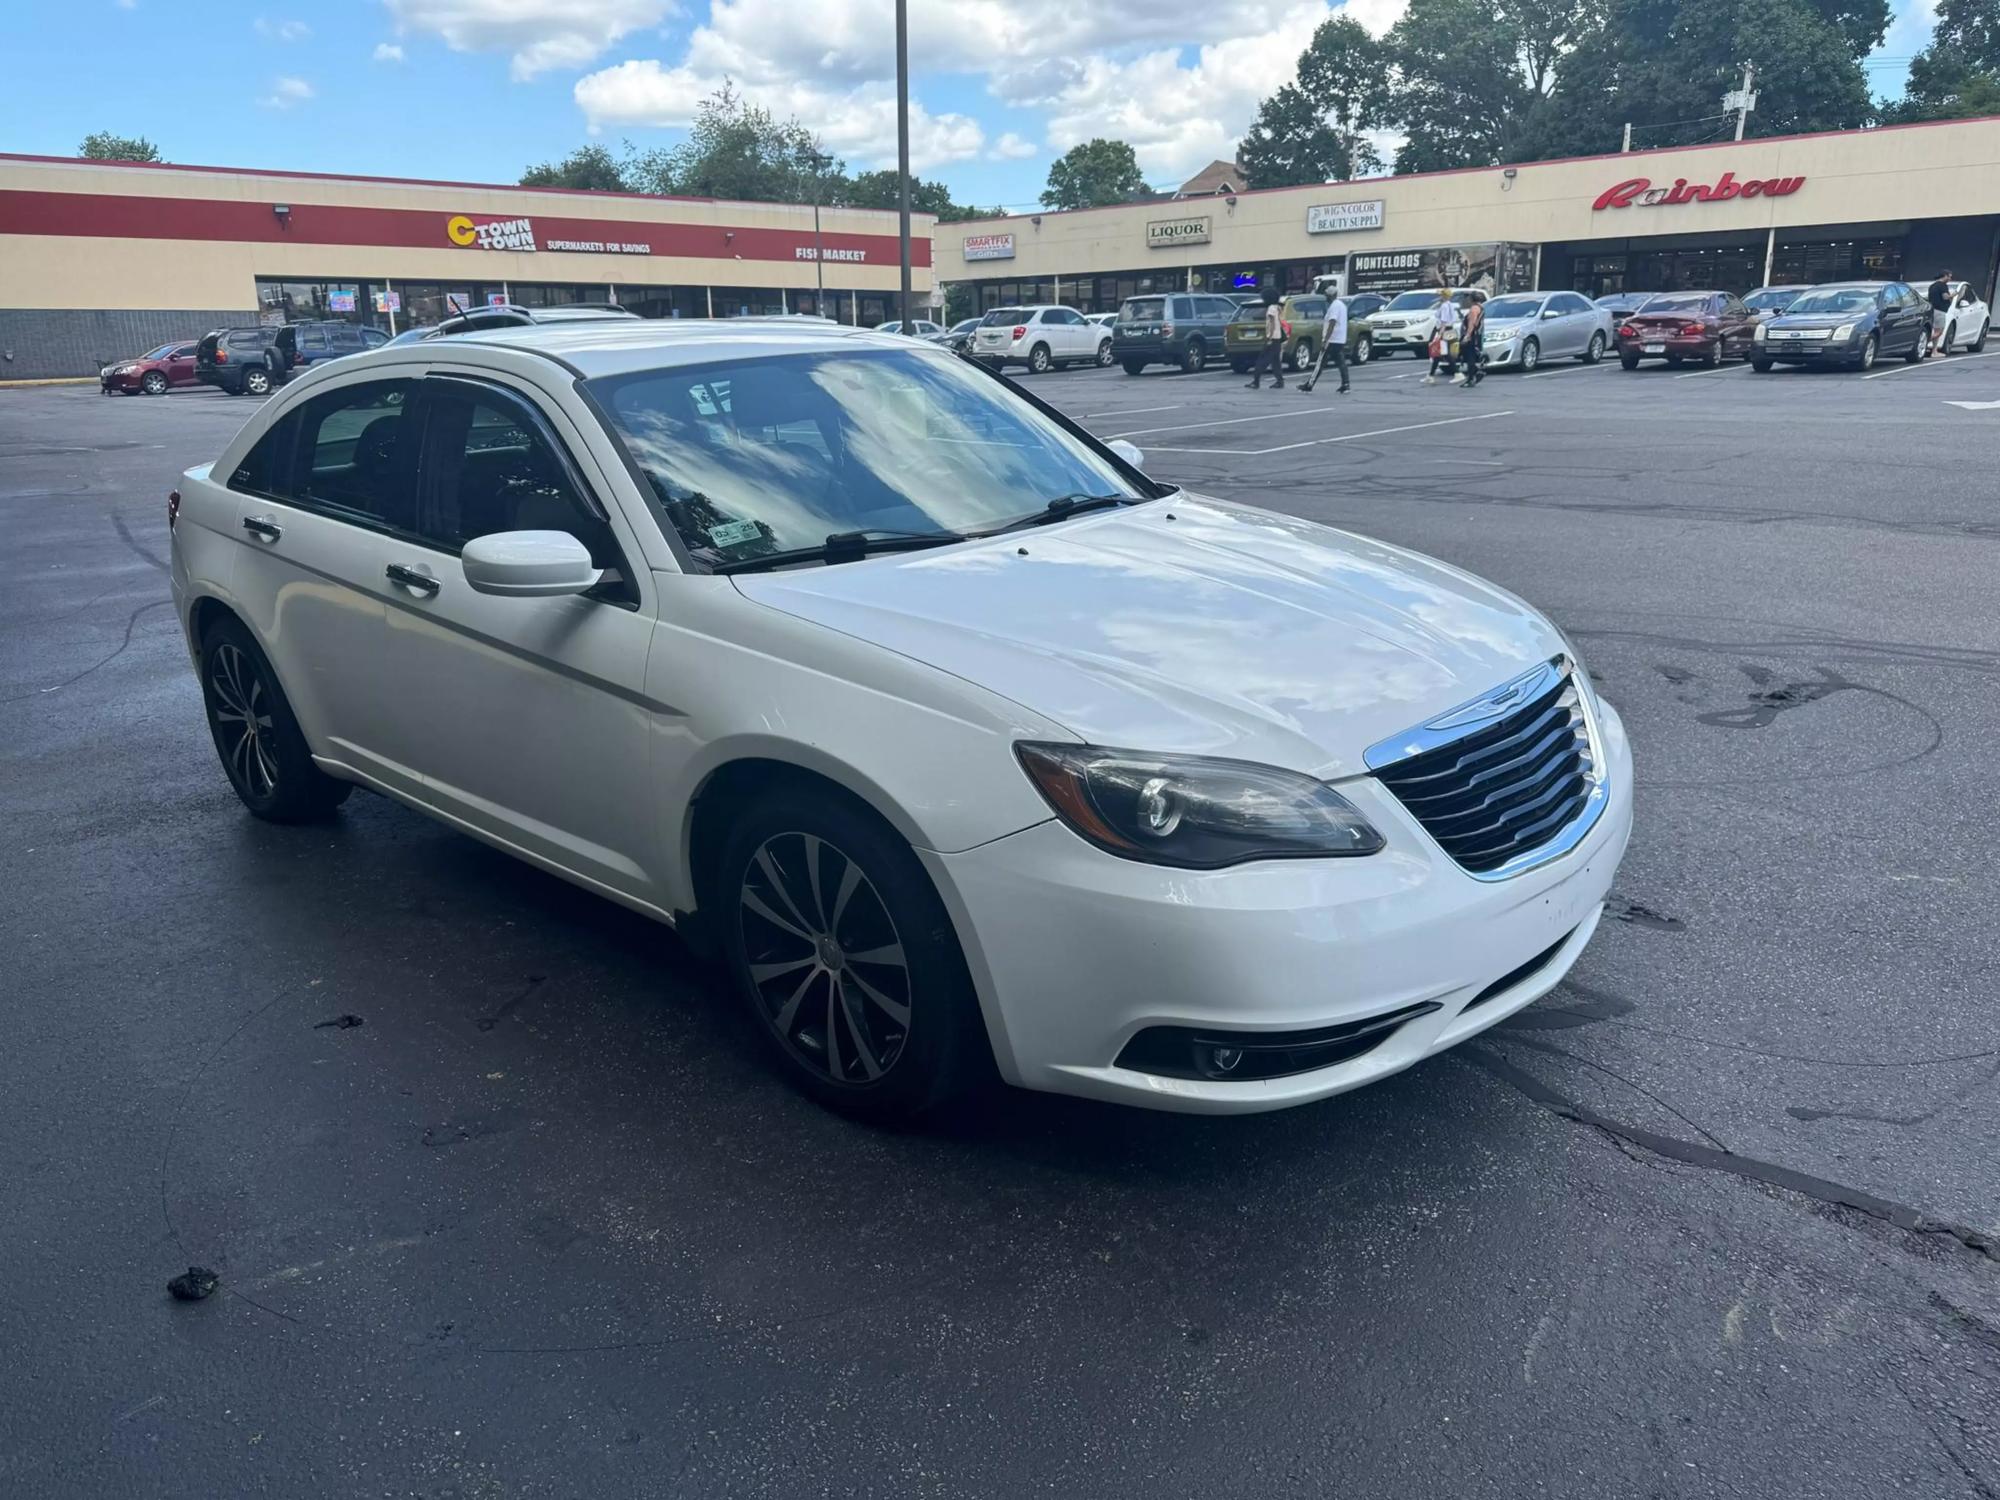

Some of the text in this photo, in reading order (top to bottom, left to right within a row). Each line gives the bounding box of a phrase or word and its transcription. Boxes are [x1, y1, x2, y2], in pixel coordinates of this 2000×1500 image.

[1592, 172, 1806, 210] Rainbow
[1324, 206, 1340, 217] WIG
[1348, 203, 1376, 214] COLOR
[475, 219, 531, 238] TOWN
[1318, 215, 1379, 229] BEAUTY SUPPLY
[1151, 223, 1204, 237] LIQUOR
[478, 231, 534, 250] TOWN
[547, 240, 604, 252] SUPERMARKETS
[606, 242, 621, 252] FOR
[622, 243, 650, 254] SAVINGS
[965, 235, 1009, 247] SMARTFIX
[822, 249, 866, 261] MARKET
[1355, 254, 1421, 271] MONTELOBOS
